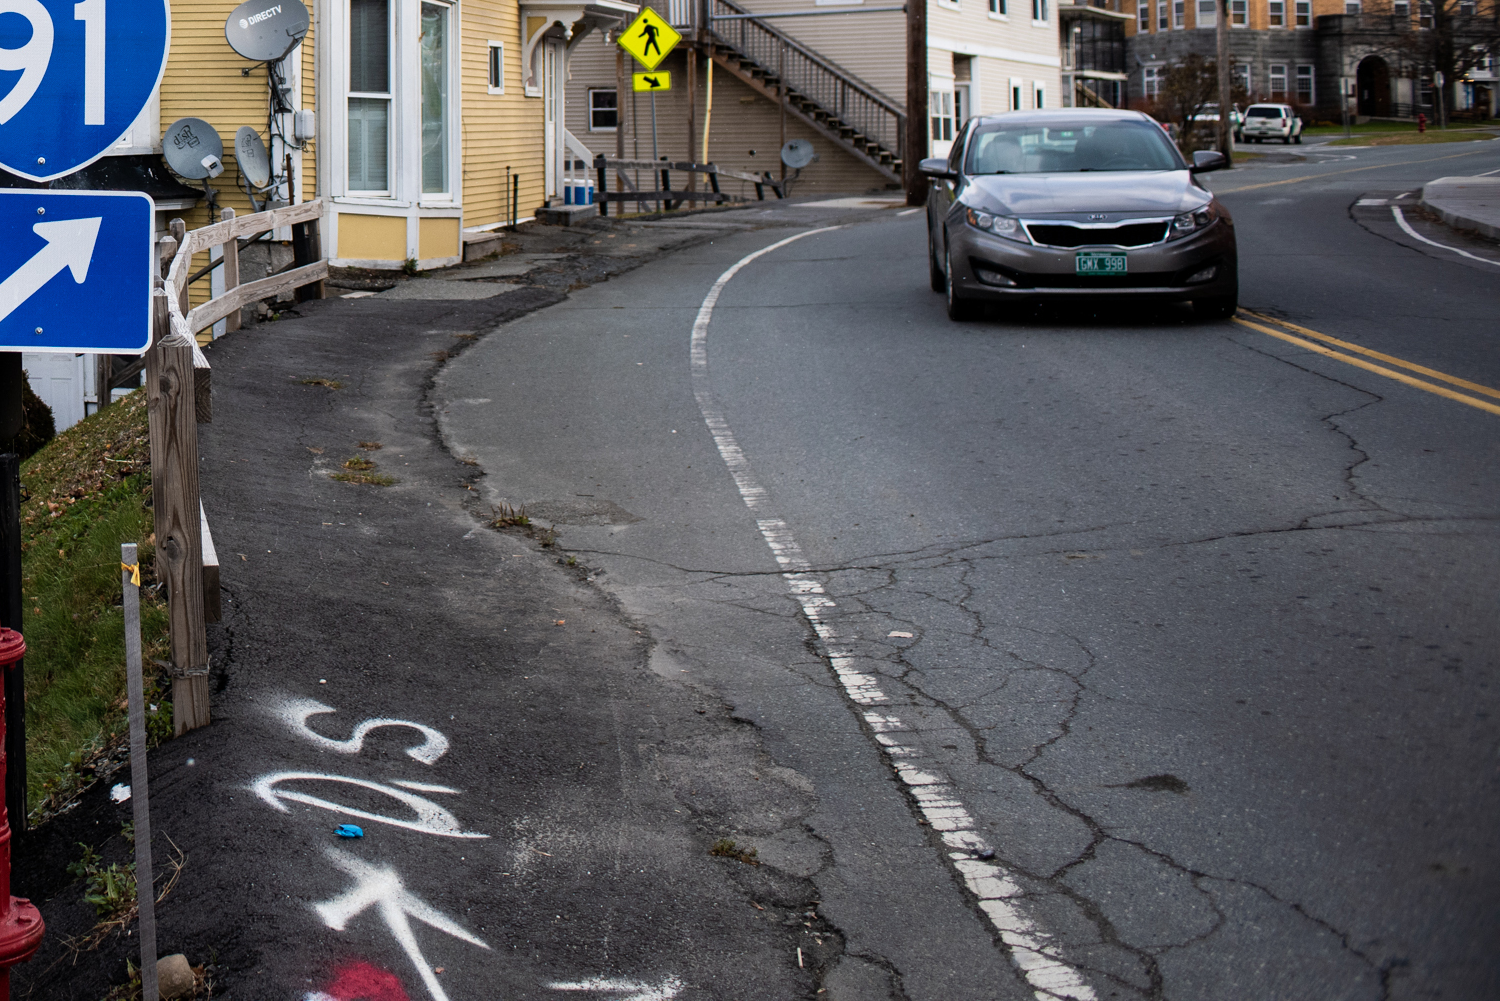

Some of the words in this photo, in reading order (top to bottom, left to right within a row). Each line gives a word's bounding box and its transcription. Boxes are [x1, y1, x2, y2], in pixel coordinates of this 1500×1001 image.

[247, 4, 283, 25] DIRECTV
[173, 126, 194, 146] dish
[1081, 258, 1100, 270] GMX
